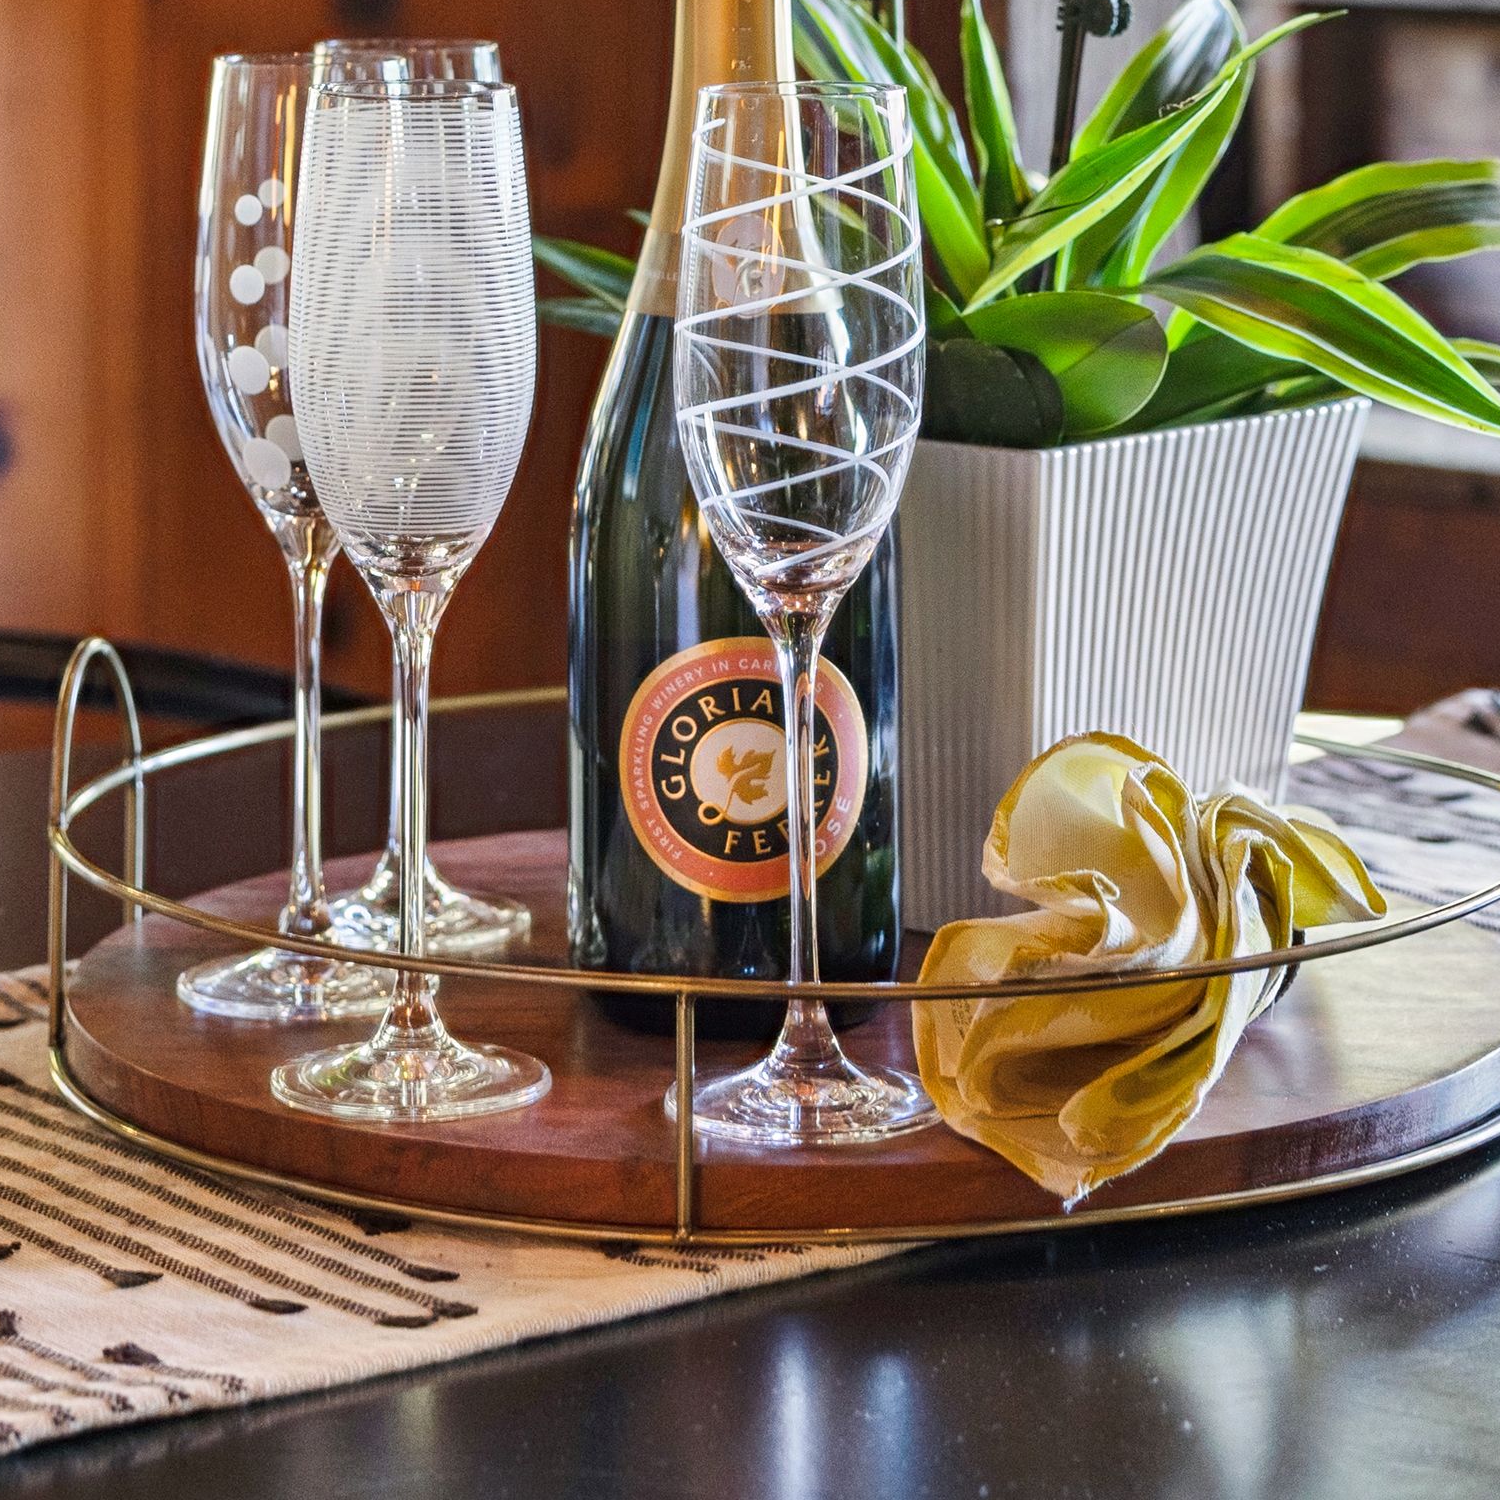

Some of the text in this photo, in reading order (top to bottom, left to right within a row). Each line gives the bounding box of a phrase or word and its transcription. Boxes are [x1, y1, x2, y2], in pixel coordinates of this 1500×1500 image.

[652, 666, 703, 710] WINERY
[712, 659, 729, 674] IN
[633, 714, 653, 810] SPARKLING
[660, 687, 774, 800] GLORIA
[723, 733, 830, 855] FEER
[647, 817, 682, 860] FIRST
